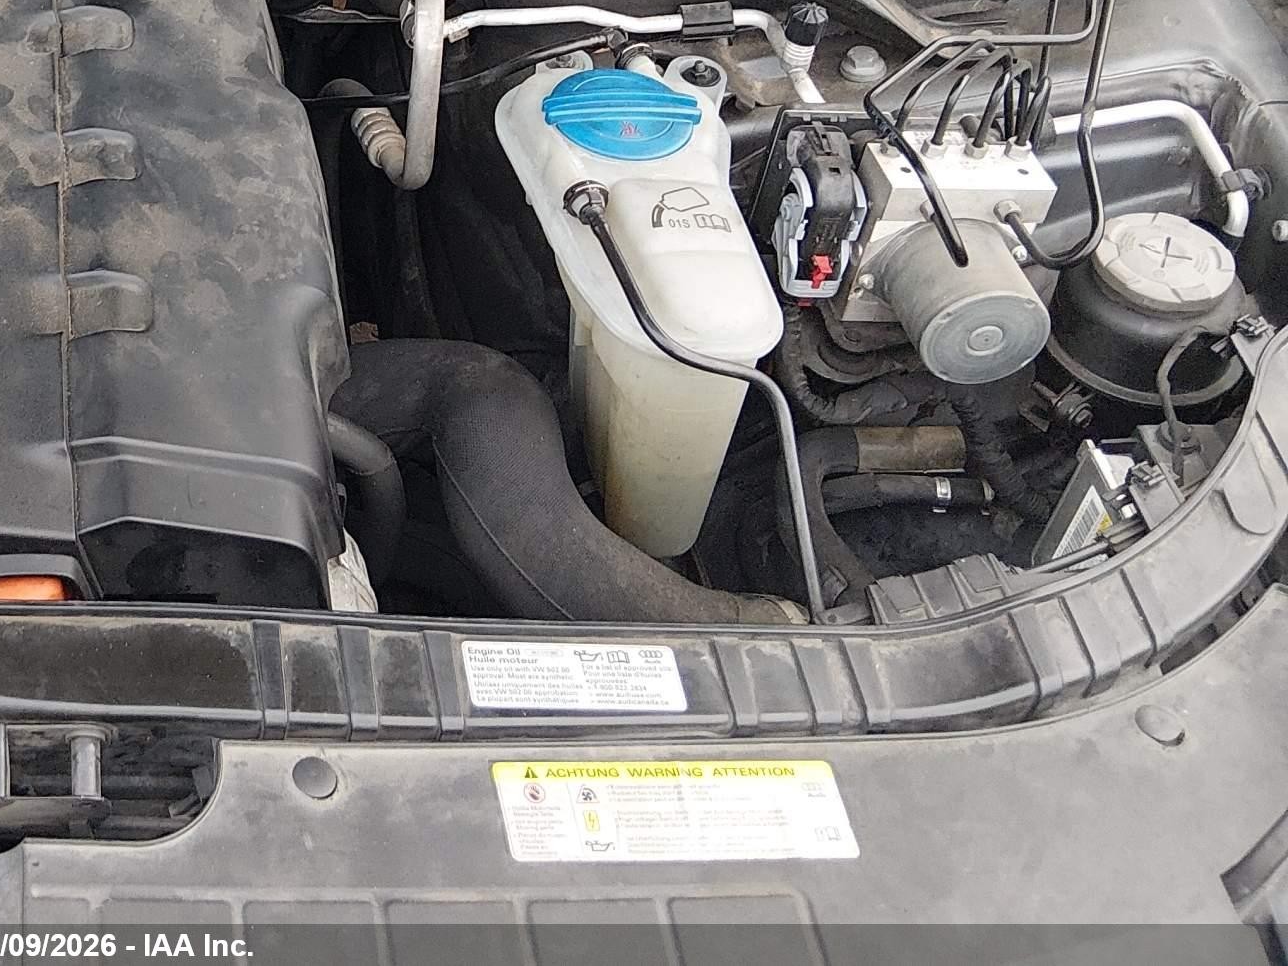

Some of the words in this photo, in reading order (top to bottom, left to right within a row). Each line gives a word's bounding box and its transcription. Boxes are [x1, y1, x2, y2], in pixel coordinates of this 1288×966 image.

[668, 218, 690, 229] 01S
[467, 646, 503, 656] Engine
[506, 648, 521, 656] Oil
[468, 656, 496, 664] Huile
[545, 766, 620, 778] ACHTUNG
[627, 766, 703, 778] WARNING
[712, 766, 796, 778] ATTENTION
